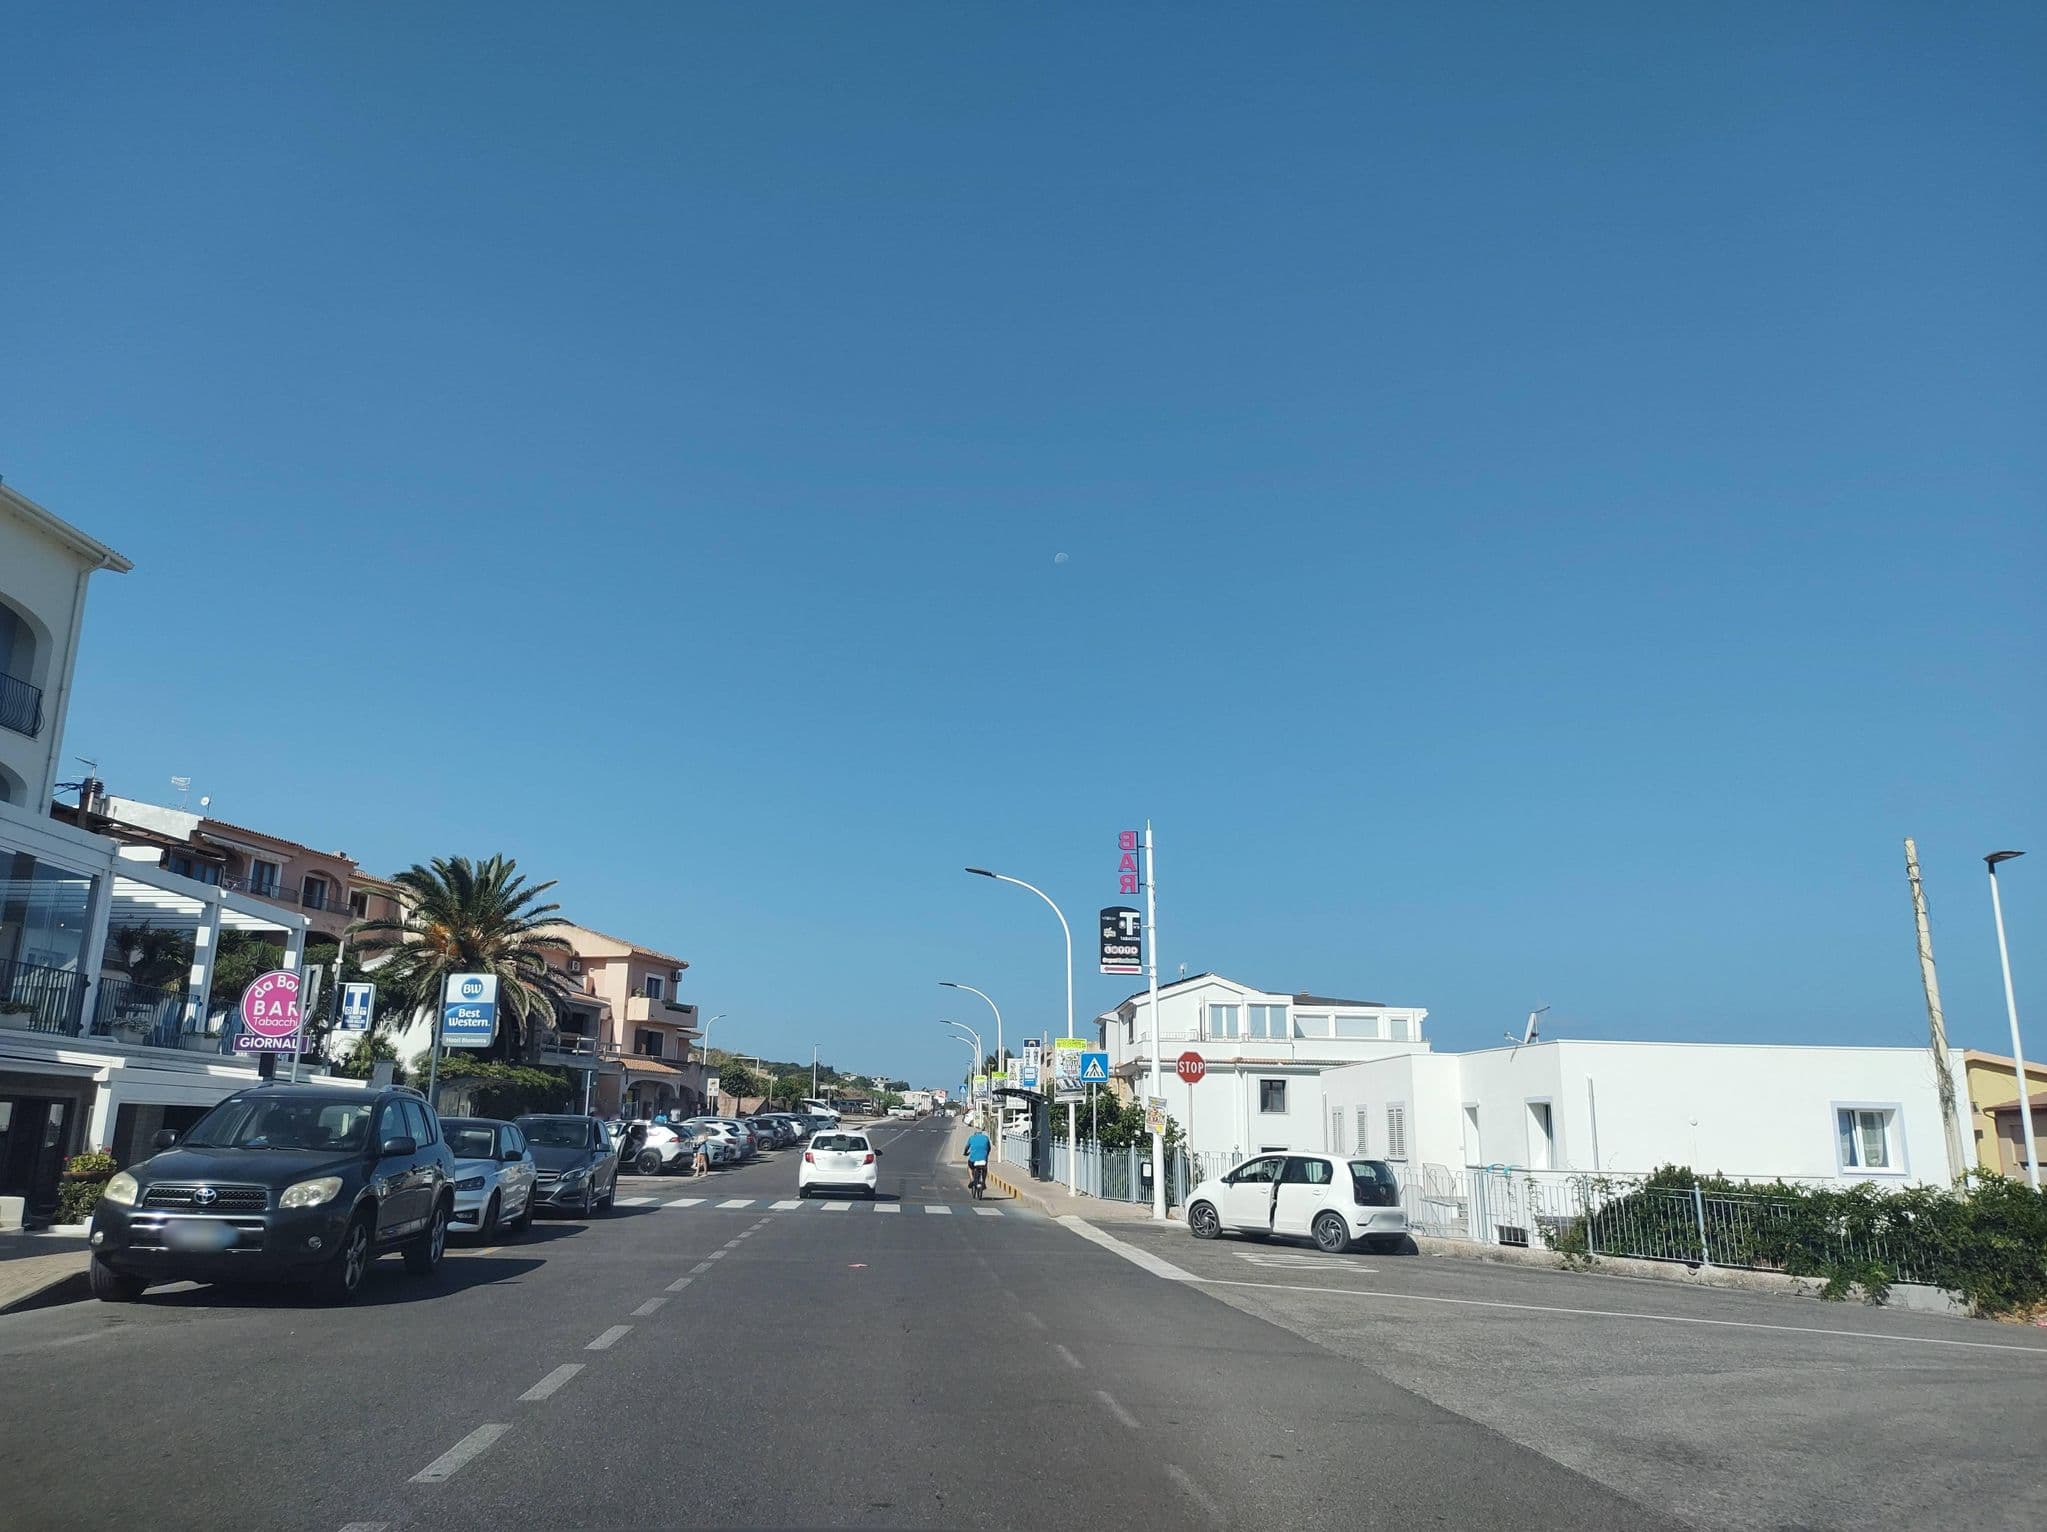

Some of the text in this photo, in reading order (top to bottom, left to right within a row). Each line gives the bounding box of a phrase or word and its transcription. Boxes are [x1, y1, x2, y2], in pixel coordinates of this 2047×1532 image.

[1119, 912, 1140, 935] T
[255, 981, 273, 998] da
[463, 984, 481, 994] BW
[253, 1000, 299, 1016] BAR
[459, 1008, 480, 1018] Best
[253, 1016, 298, 1026] Tabacchi
[240, 1037, 299, 1048] GIORNAL
[1179, 1061, 1204, 1074] STOP
